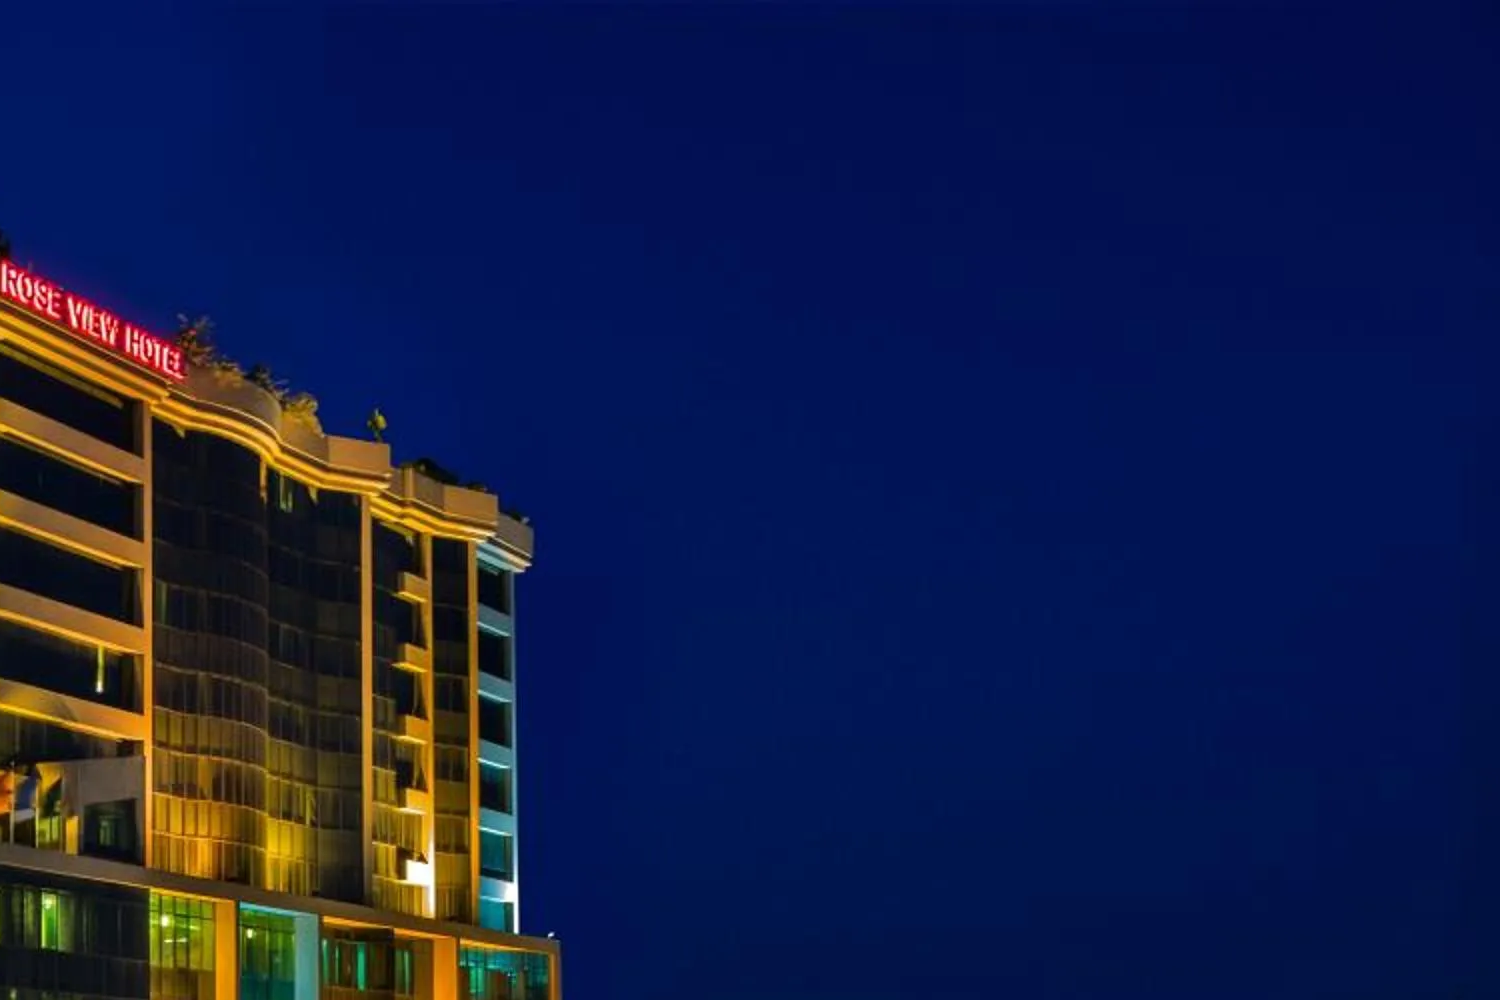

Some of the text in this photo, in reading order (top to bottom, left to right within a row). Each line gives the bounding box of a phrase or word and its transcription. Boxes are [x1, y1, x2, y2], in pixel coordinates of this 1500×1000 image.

[0, 260, 186, 380] ROSE VIEW HOTEL
